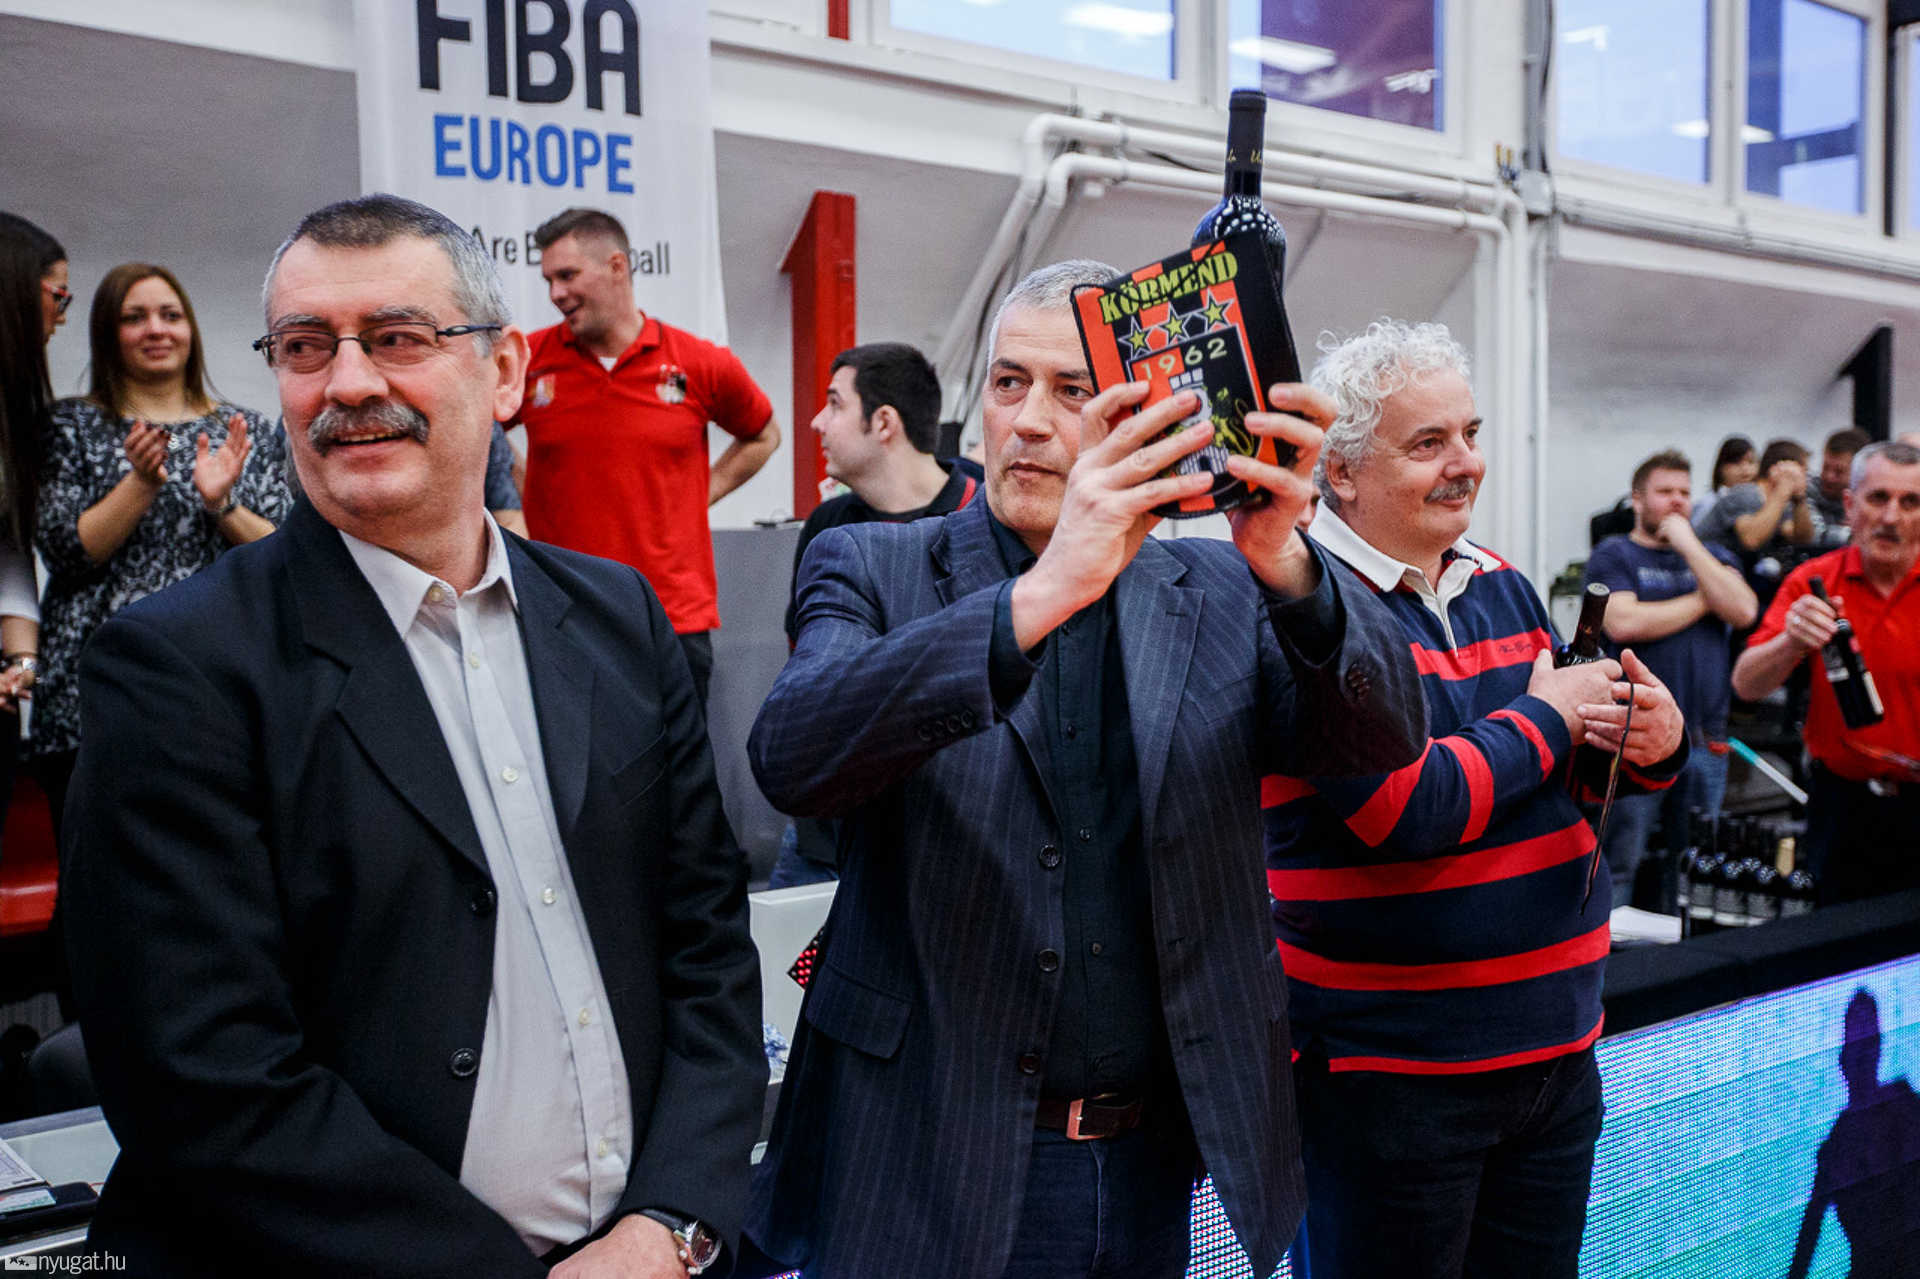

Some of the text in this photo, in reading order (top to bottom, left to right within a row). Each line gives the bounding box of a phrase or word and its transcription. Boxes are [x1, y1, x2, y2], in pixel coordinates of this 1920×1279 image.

[417, 0, 642, 117] FIBA
[433, 113, 636, 195] EUROPE
[1099, 251, 1238, 325] KÖRMEND
[1141, 337, 1228, 380] 1962
